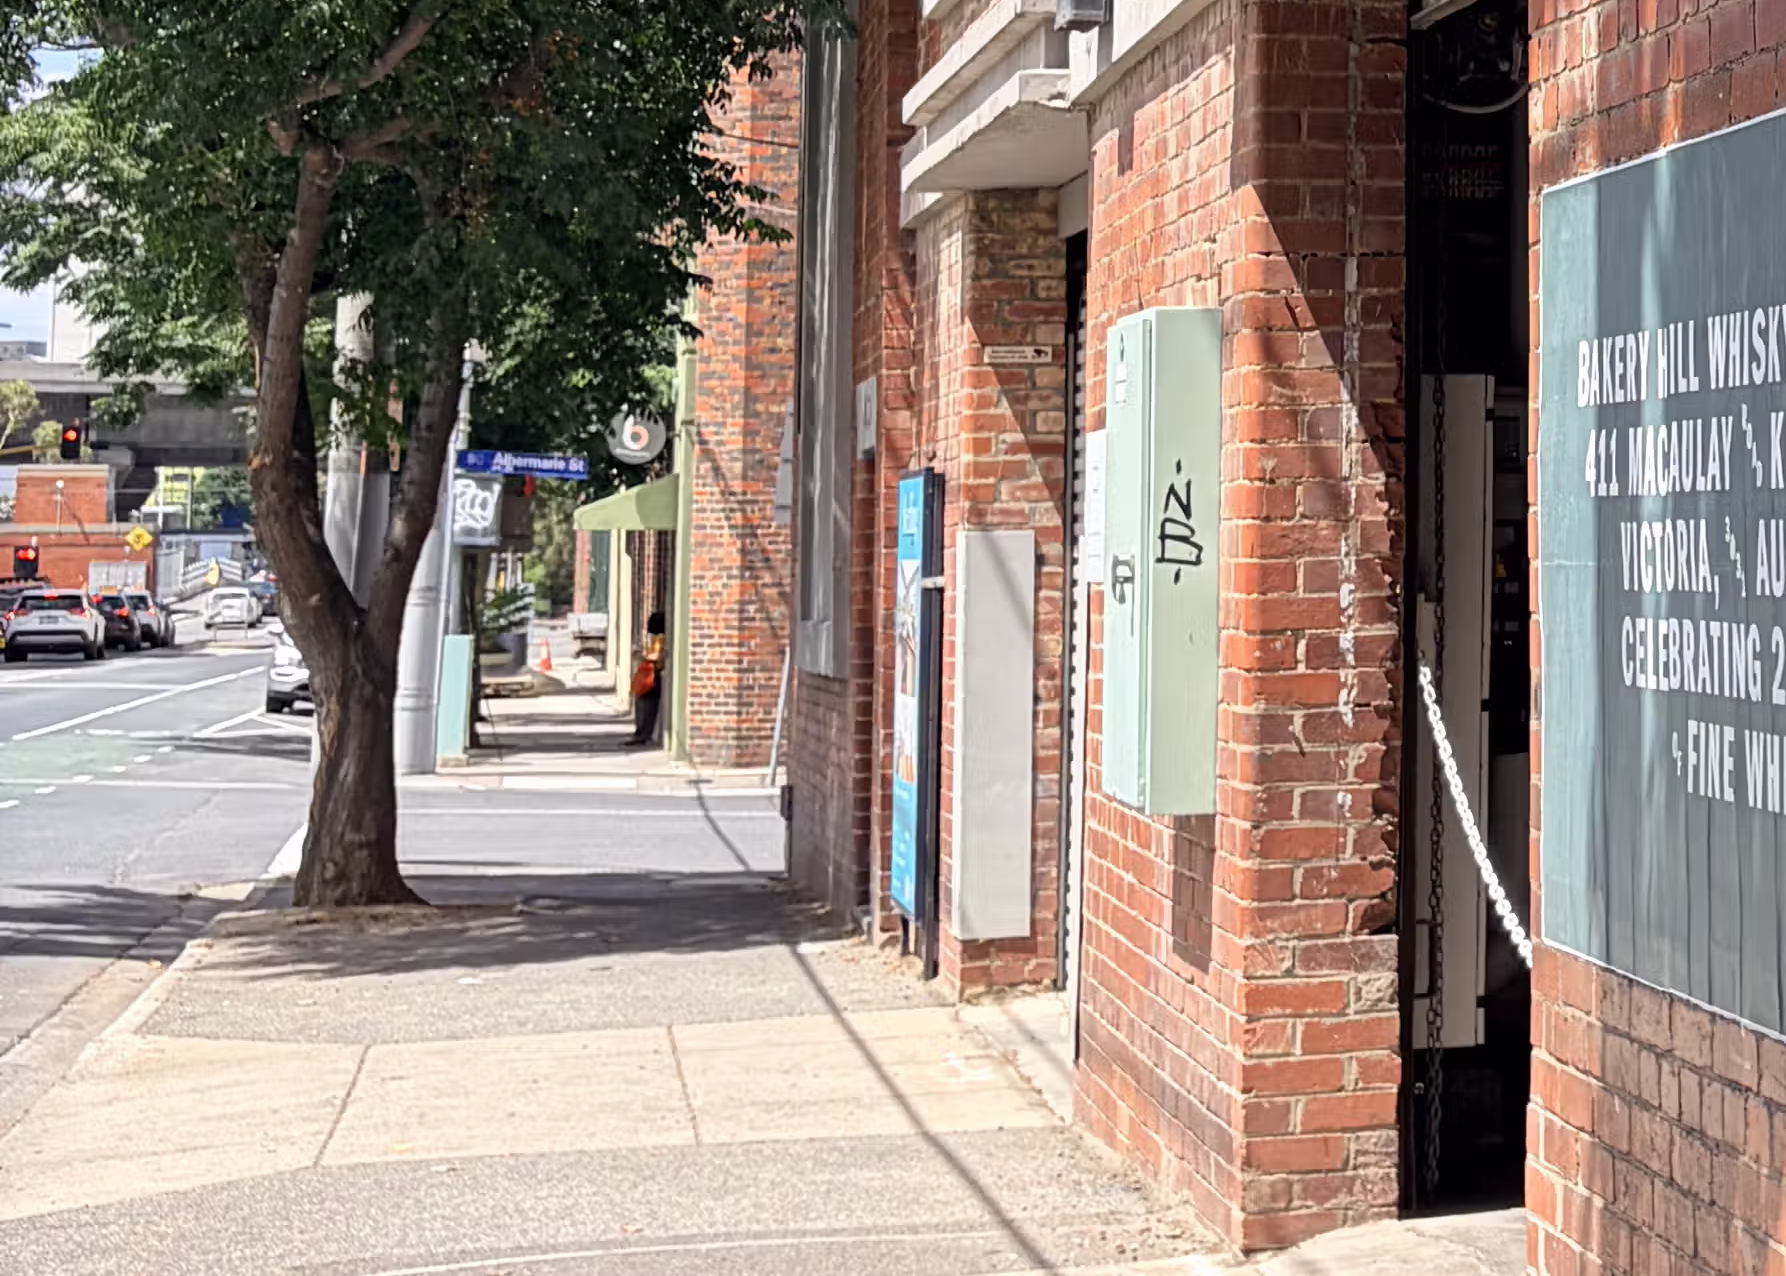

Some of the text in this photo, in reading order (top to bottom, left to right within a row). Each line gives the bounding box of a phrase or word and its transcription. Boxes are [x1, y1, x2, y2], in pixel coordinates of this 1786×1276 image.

[1577, 330, 1651, 407] BAKERY
[1657, 320, 1699, 398] HILL
[1585, 428, 1619, 497] 411
[1628, 415, 1734, 496] MACAULAY
[1620, 518, 1720, 610] VICTORIA,
[1621, 616, 1762, 702] CELEBRATING
[1687, 719, 1735, 802] FINE
